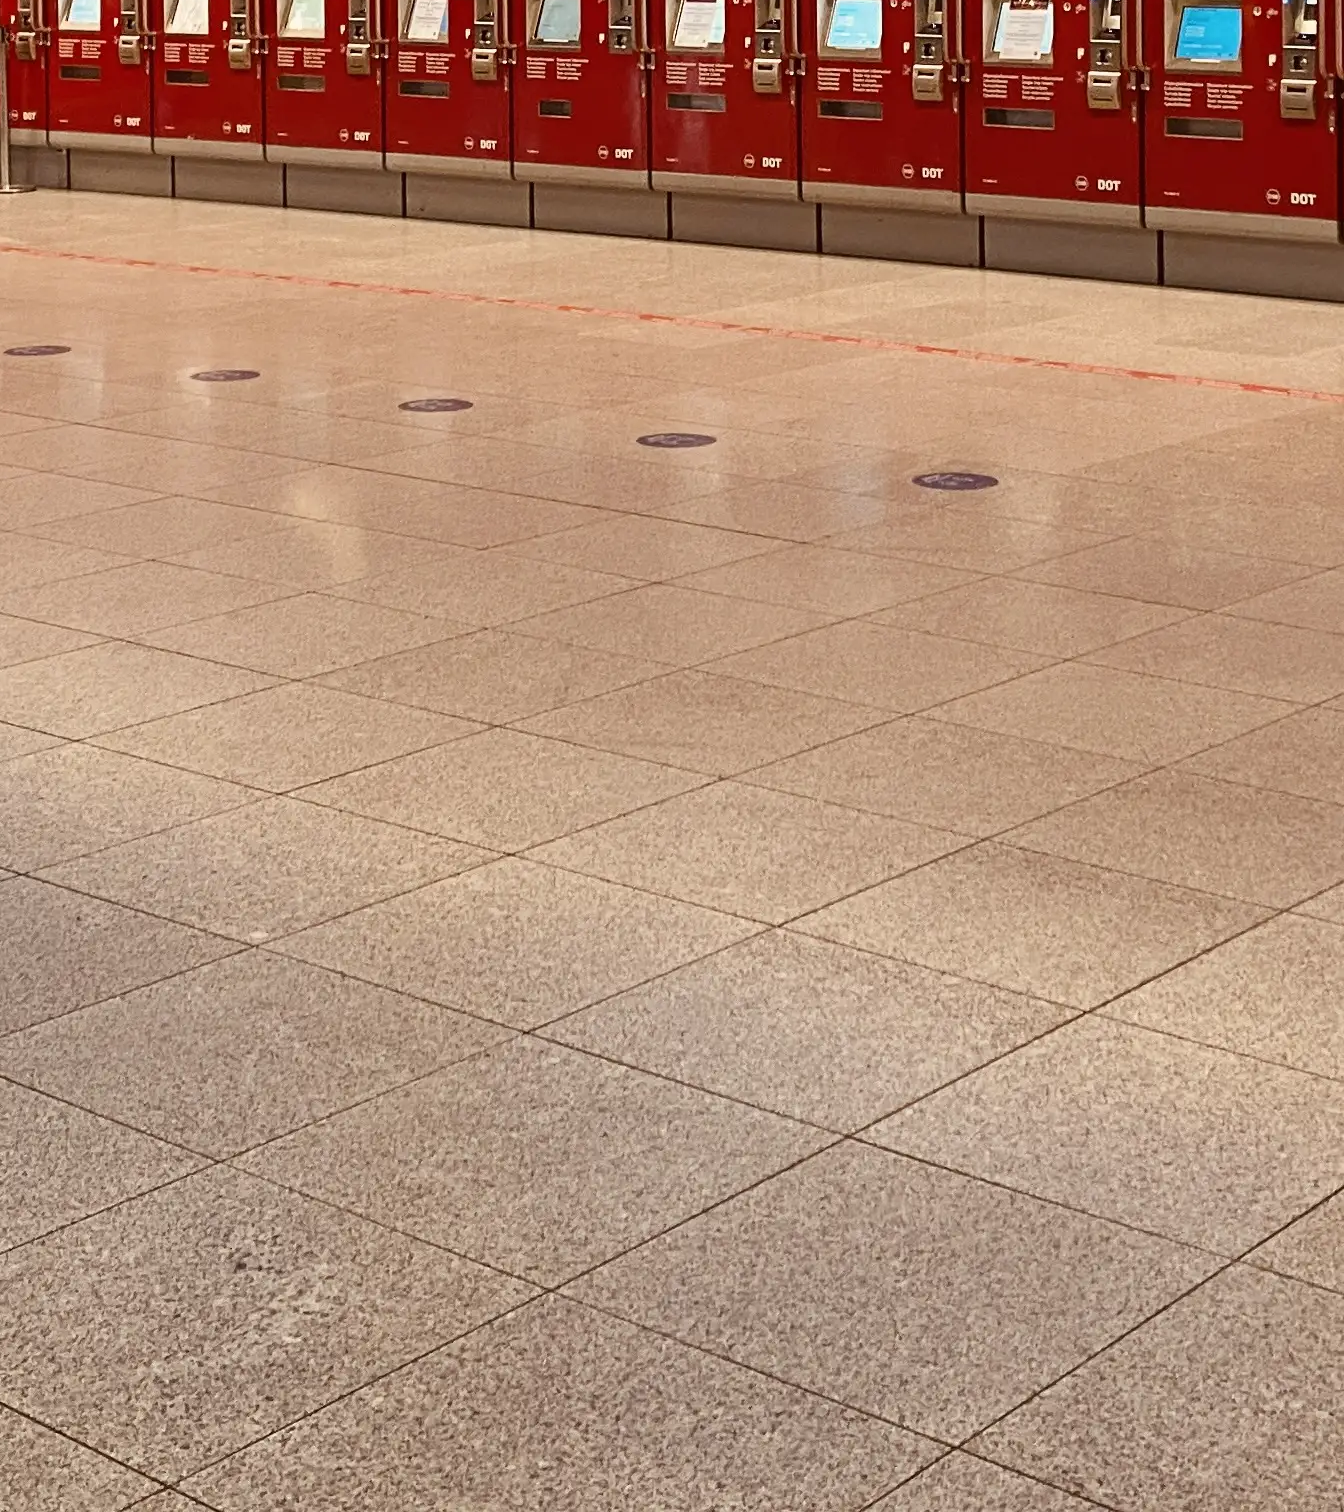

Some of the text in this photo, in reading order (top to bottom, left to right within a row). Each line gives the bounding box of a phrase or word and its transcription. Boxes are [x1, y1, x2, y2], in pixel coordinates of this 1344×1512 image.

[480, 139, 498, 150] DOT
[615, 148, 634, 159] DOT
[762, 157, 783, 169] DOT
[921, 167, 944, 179] DOT
[1097, 179, 1122, 192] DOT
[1290, 192, 1317, 206] DOT
